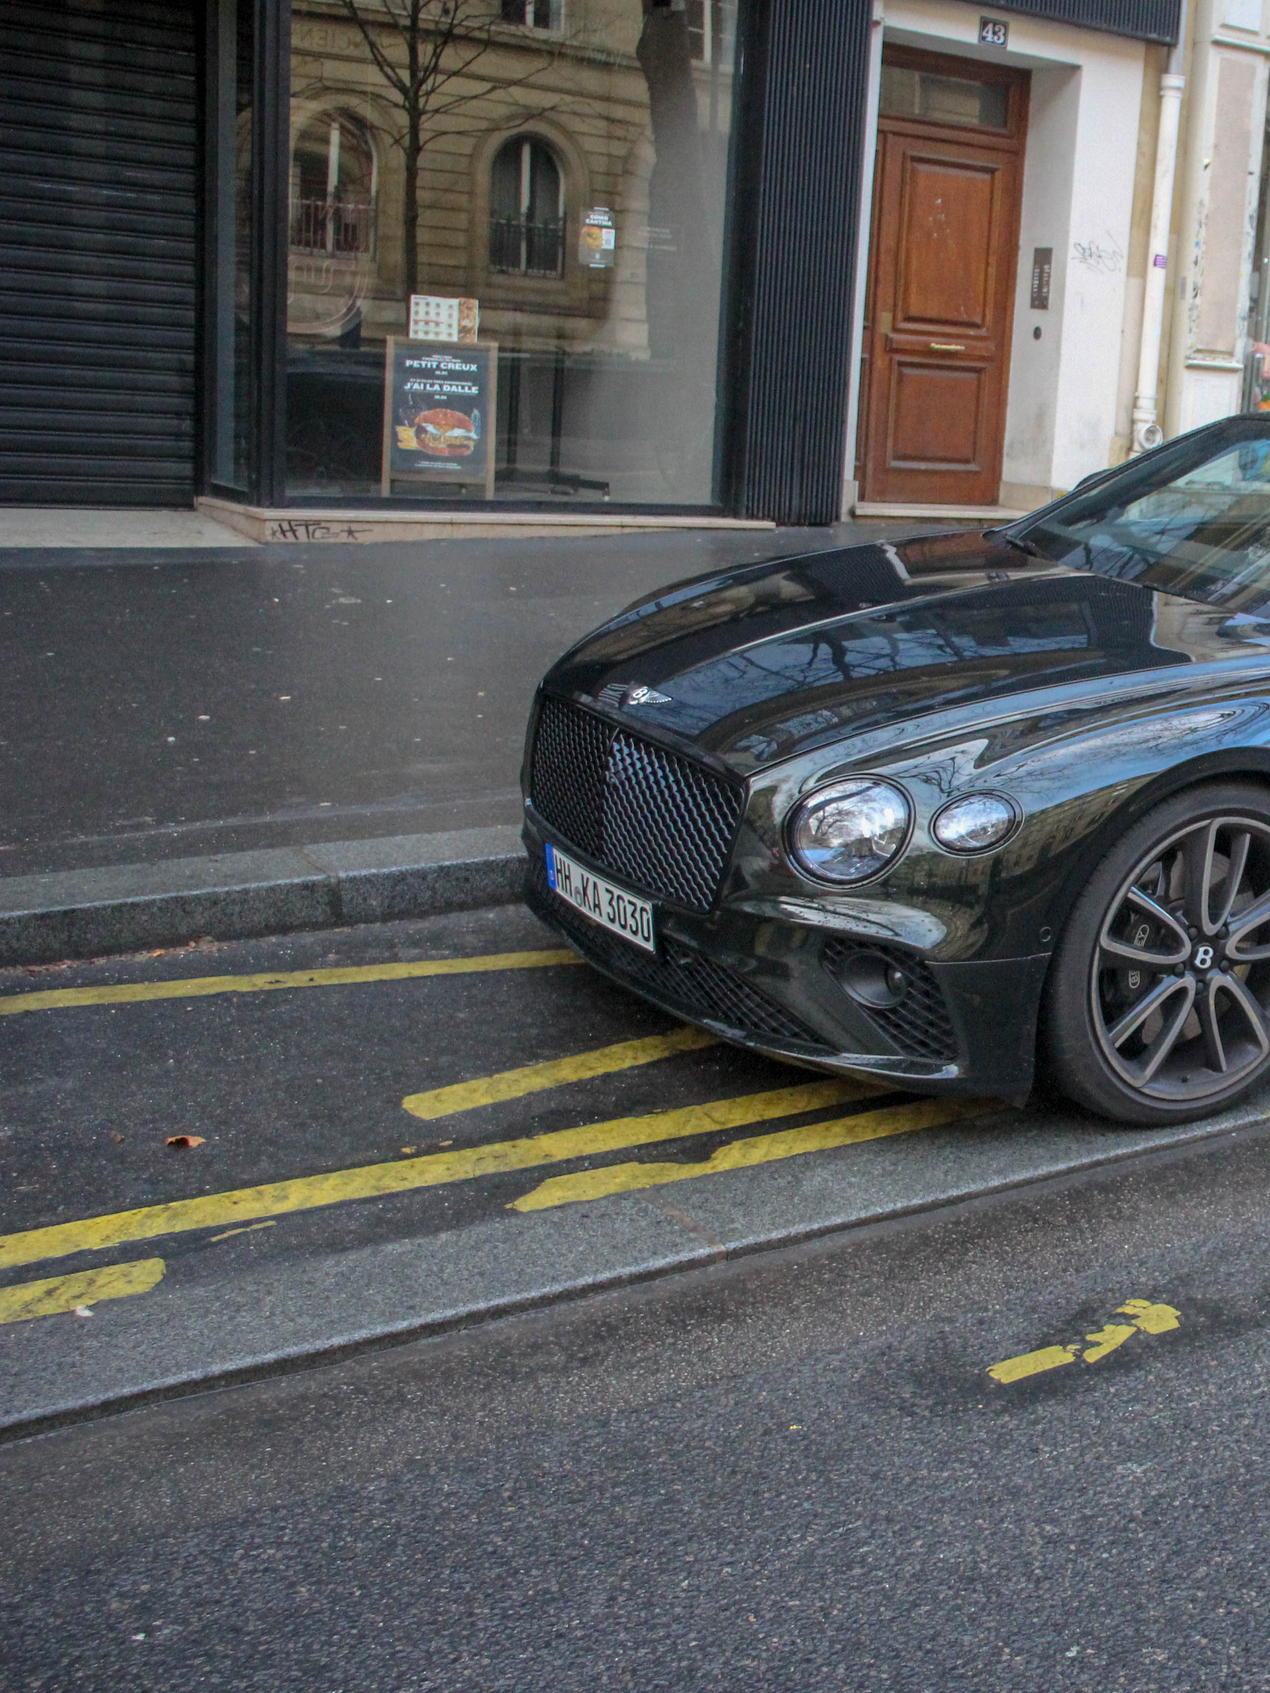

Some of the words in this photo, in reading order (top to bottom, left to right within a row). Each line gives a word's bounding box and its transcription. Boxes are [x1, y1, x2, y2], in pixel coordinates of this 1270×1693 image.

[982, 22, 1006, 45] 43
[405, 359, 439, 370] PETIT
[440, 361, 478, 372] CREUX
[403, 382, 424, 391] J'AI
[426, 383, 441, 392] LA
[443, 384, 480, 394] DALLE
[554, 853, 573, 898] HH
[581, 873, 603, 918] KA
[605, 886, 652, 943] 3030
